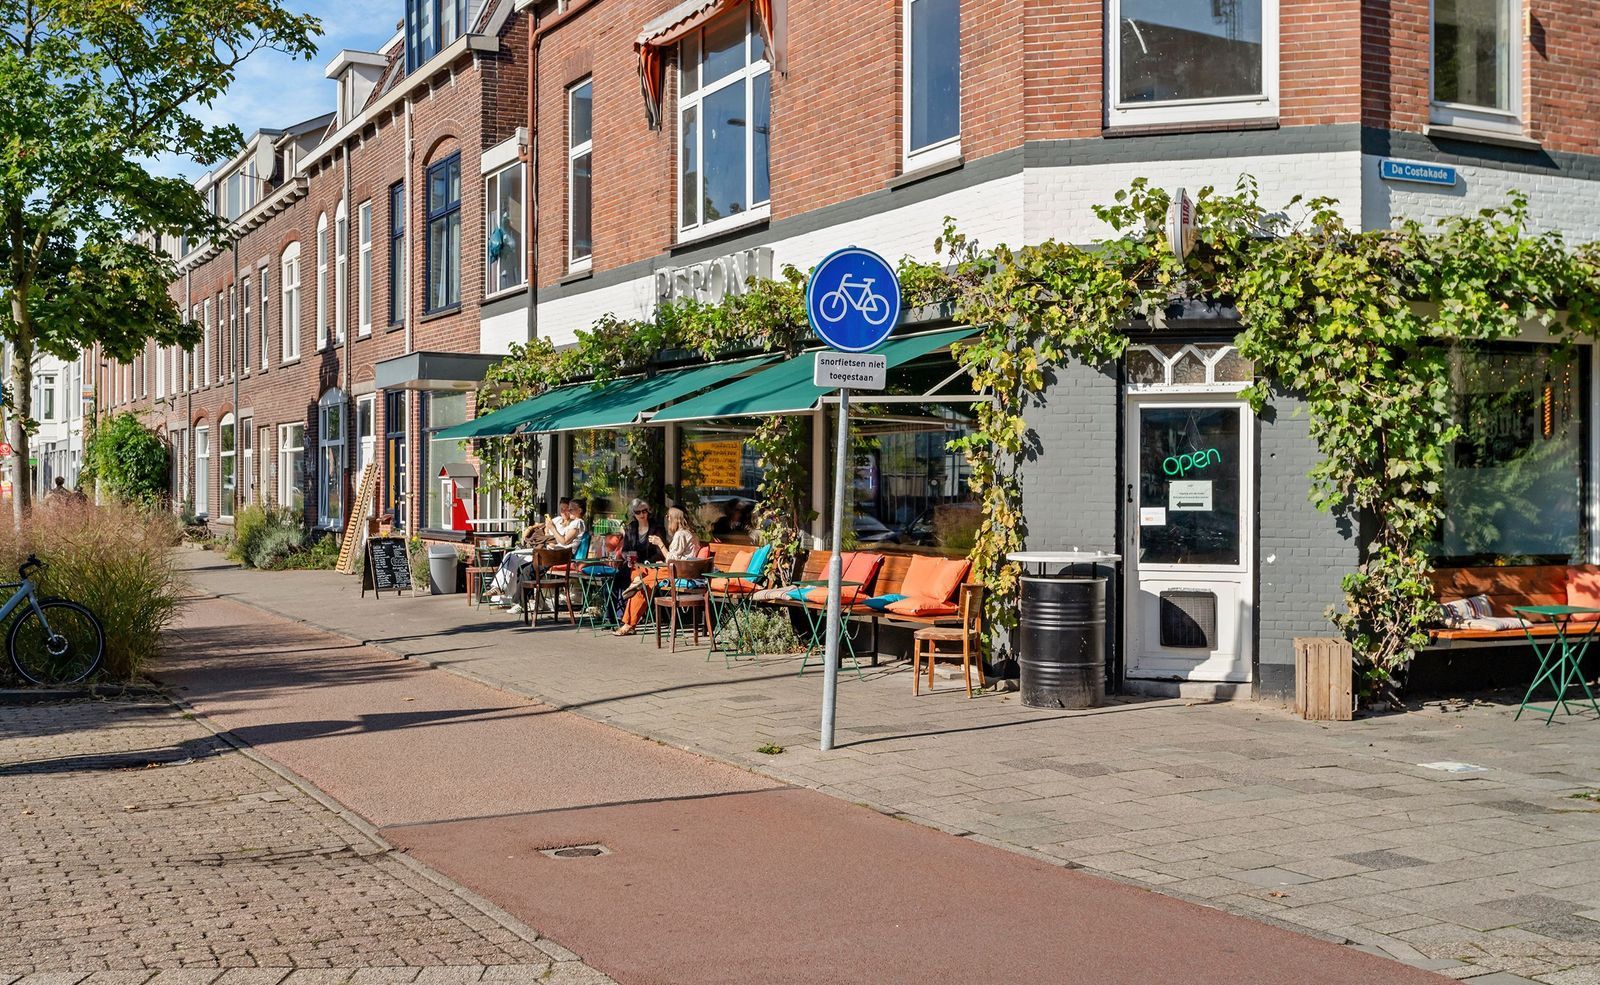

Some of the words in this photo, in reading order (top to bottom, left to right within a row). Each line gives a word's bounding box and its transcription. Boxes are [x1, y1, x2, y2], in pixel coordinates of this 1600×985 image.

[1391, 164, 1403, 175] Da
[1404, 166, 1448, 179] Costakade
[820, 358, 866, 368] snorfietsen
[868, 360, 885, 369] niet
[829, 372, 874, 382] toegestaan
[1162, 448, 1221, 477] open
